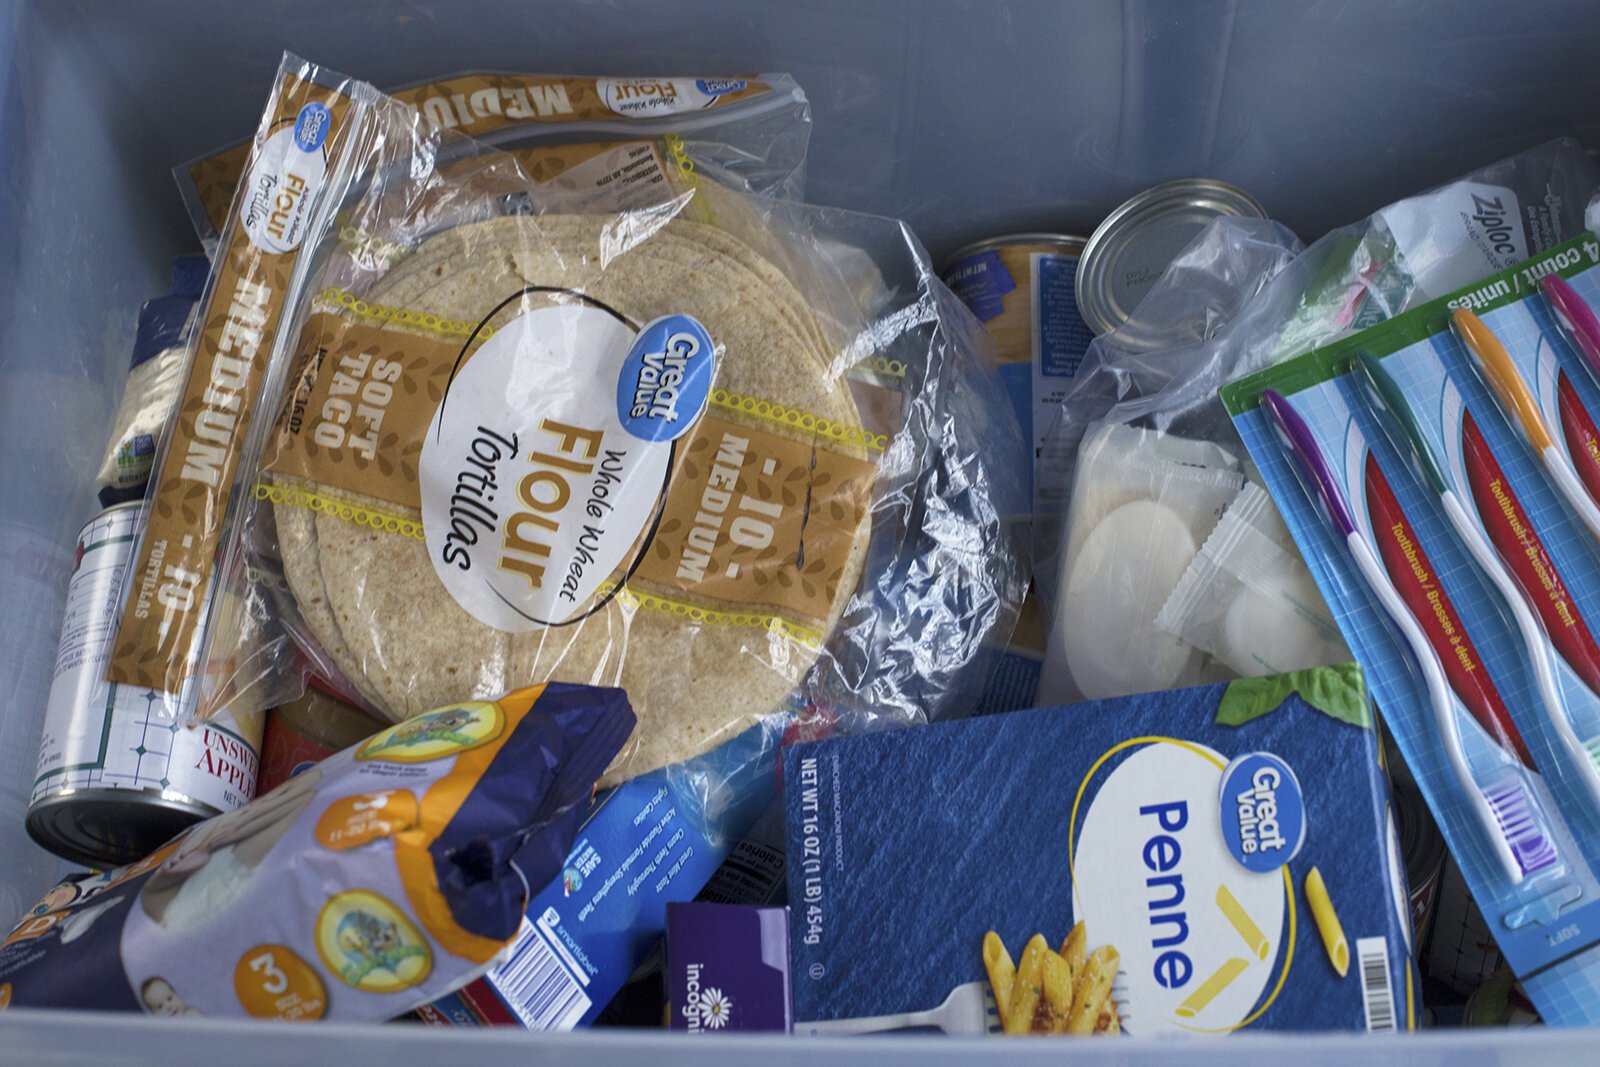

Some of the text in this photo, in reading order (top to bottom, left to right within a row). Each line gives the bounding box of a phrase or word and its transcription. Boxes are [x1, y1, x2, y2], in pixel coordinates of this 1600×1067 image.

[408, 83, 575, 132] MEDIU
[614, 79, 678, 104] Flour
[245, 173, 279, 229] Tortillas
[265, 173, 305, 241] Flour
[1471, 193, 1516, 255] Ziploc
[1522, 247, 1581, 287] count
[1583, 241, 1600, 263] 4
[180, 278, 272, 487] MEDIUM
[314, 353, 374, 450] TACO
[348, 357, 402, 461] SOFT
[629, 351, 658, 419] Value
[648, 331, 700, 424] Great
[442, 424, 520, 572] Tortillas
[496, 417, 605, 590] Flour
[558, 448, 627, 603] Whole Wheat
[676, 432, 750, 583] MEDIUM
[1489, 478, 1528, 544] Toothbrush
[135, 539, 168, 620] TORTILLAS
[1390, 521, 1429, 586] Toothbrush
[1426, 589, 1456, 638] Brosses
[1454, 644, 1477, 674] dent
[223, 789, 238, 808] NET
[1236, 787, 1258, 855] Value
[1252, 766, 1286, 852] Great
[580, 852, 601, 878] SAVE
[801, 758, 823, 945] NET WT 16 OZ (1 LB) 454g
[1139, 799, 1194, 989] Penne
[1549, 923, 1582, 948] SOFT
[249, 951, 289, 994] 3
